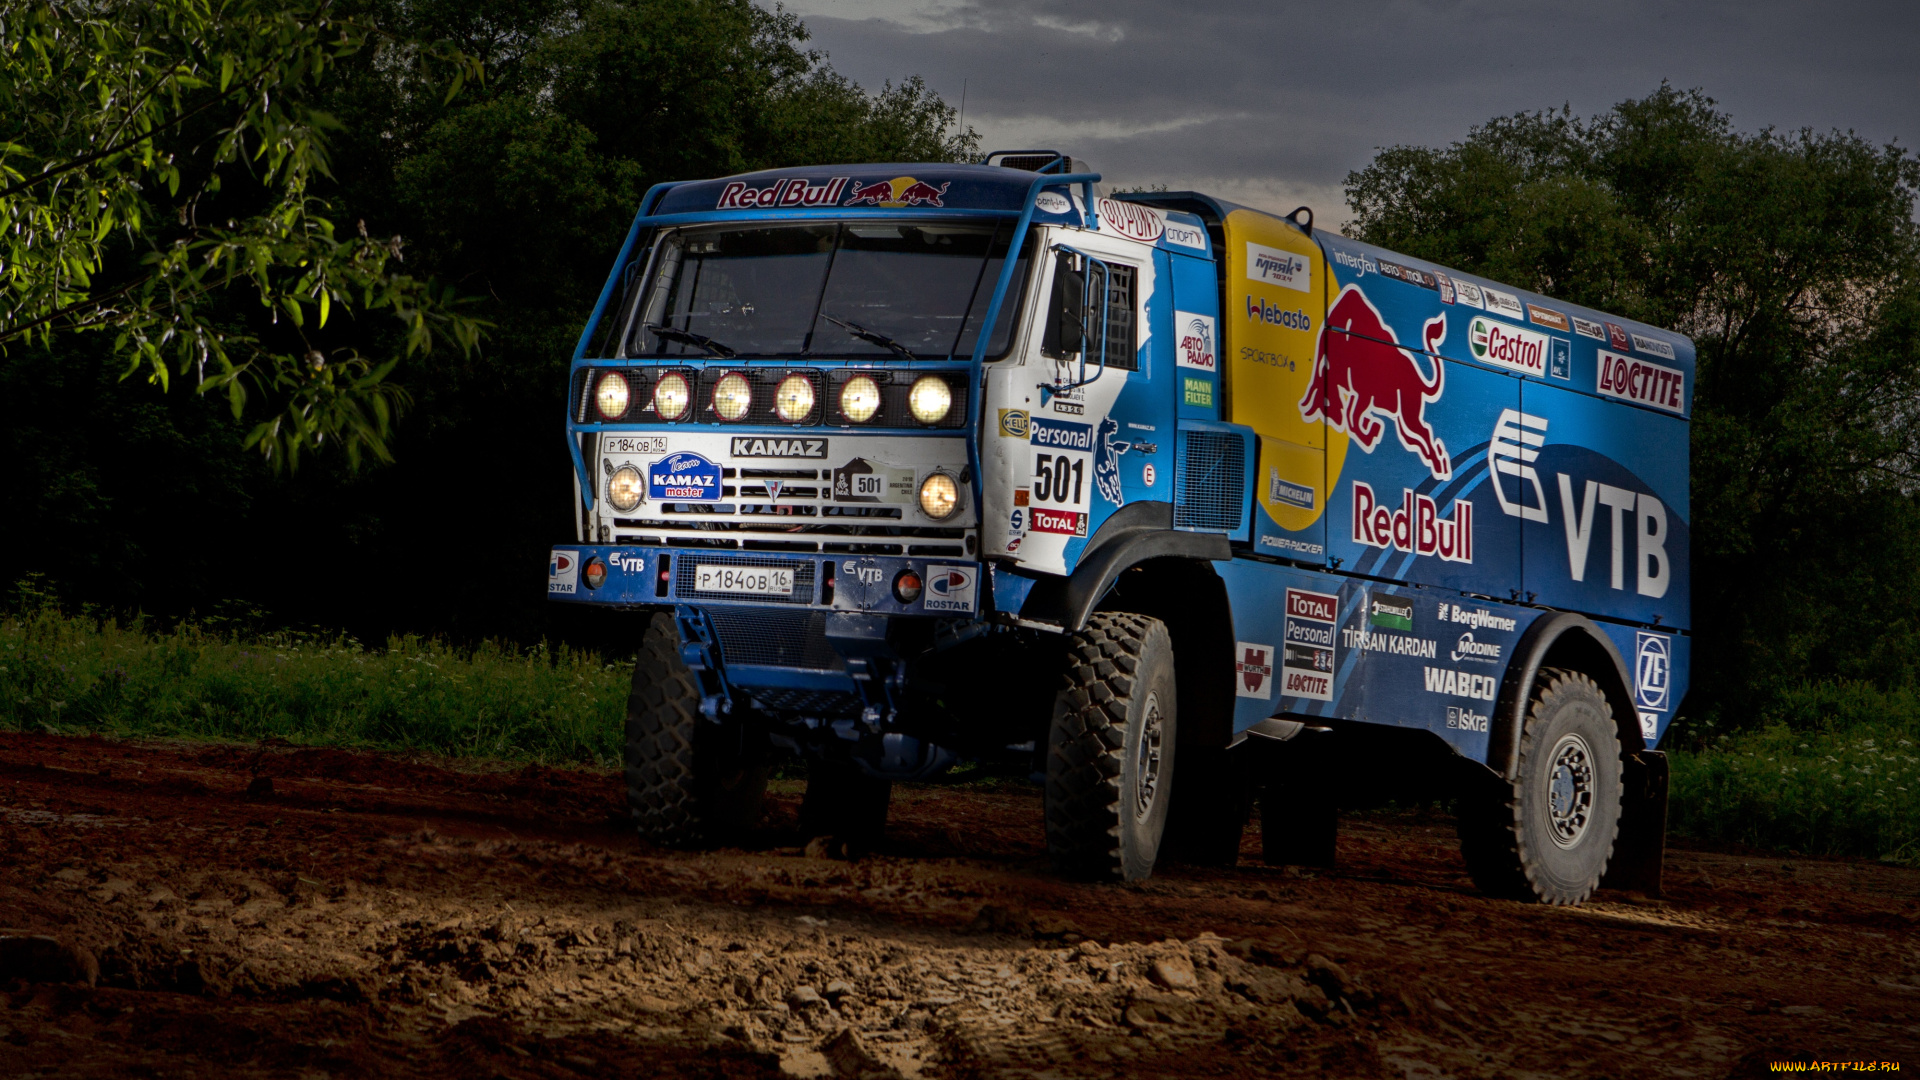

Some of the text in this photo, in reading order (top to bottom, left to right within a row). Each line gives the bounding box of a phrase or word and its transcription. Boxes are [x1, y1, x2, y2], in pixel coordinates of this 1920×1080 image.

[716, 177, 850, 209] Red Bull
[1167, 228, 1194, 243] СПОРТ
[1332, 248, 1378, 277] interfax
[1246, 294, 1311, 332] Webasto
[1180, 335, 1203, 352] АВТО
[1488, 326, 1544, 370] Castrol
[1187, 350, 1214, 367] РАДИО
[1185, 379, 1212, 394] MANN
[1600, 355, 1682, 408] LOCTITE
[1185, 391, 1212, 406] FILTER
[1005, 419, 1028, 430] HELLA
[653, 438, 664, 447] 16
[1030, 421, 1092, 449] Personal
[732, 438, 824, 457] KAMAZ
[669, 455, 701, 473] Team
[653, 474, 715, 487] KAMAZ
[1034, 453, 1084, 505] 501
[1146, 468, 1152, 483] E
[665, 487, 704, 498] master
[858, 477, 881, 493] 501
[1279, 485, 1313, 503] MICHELIN
[1035, 512, 1075, 531] TOTAL
[1352, 480, 1473, 565] Red Bull
[1556, 471, 1671, 599] VTB
[621, 558, 645, 572] VTB
[772, 571, 787, 586] 16
[857, 567, 883, 582] VTB
[549, 583, 573, 592] STAR
[925, 599, 970, 611] ROSTAR
[1290, 594, 1333, 619] TOTAL
[1450, 604, 1517, 632] BorgWarner
[1287, 620, 1334, 645] Personal
[1389, 635, 1437, 659] KARDAN
[1457, 640, 1502, 657] MODINE
[1641, 651, 1667, 692] ZF
[1286, 673, 1328, 695] LOCTITE
[1424, 666, 1496, 701] WABCO
[1458, 707, 1488, 732] Iskra
